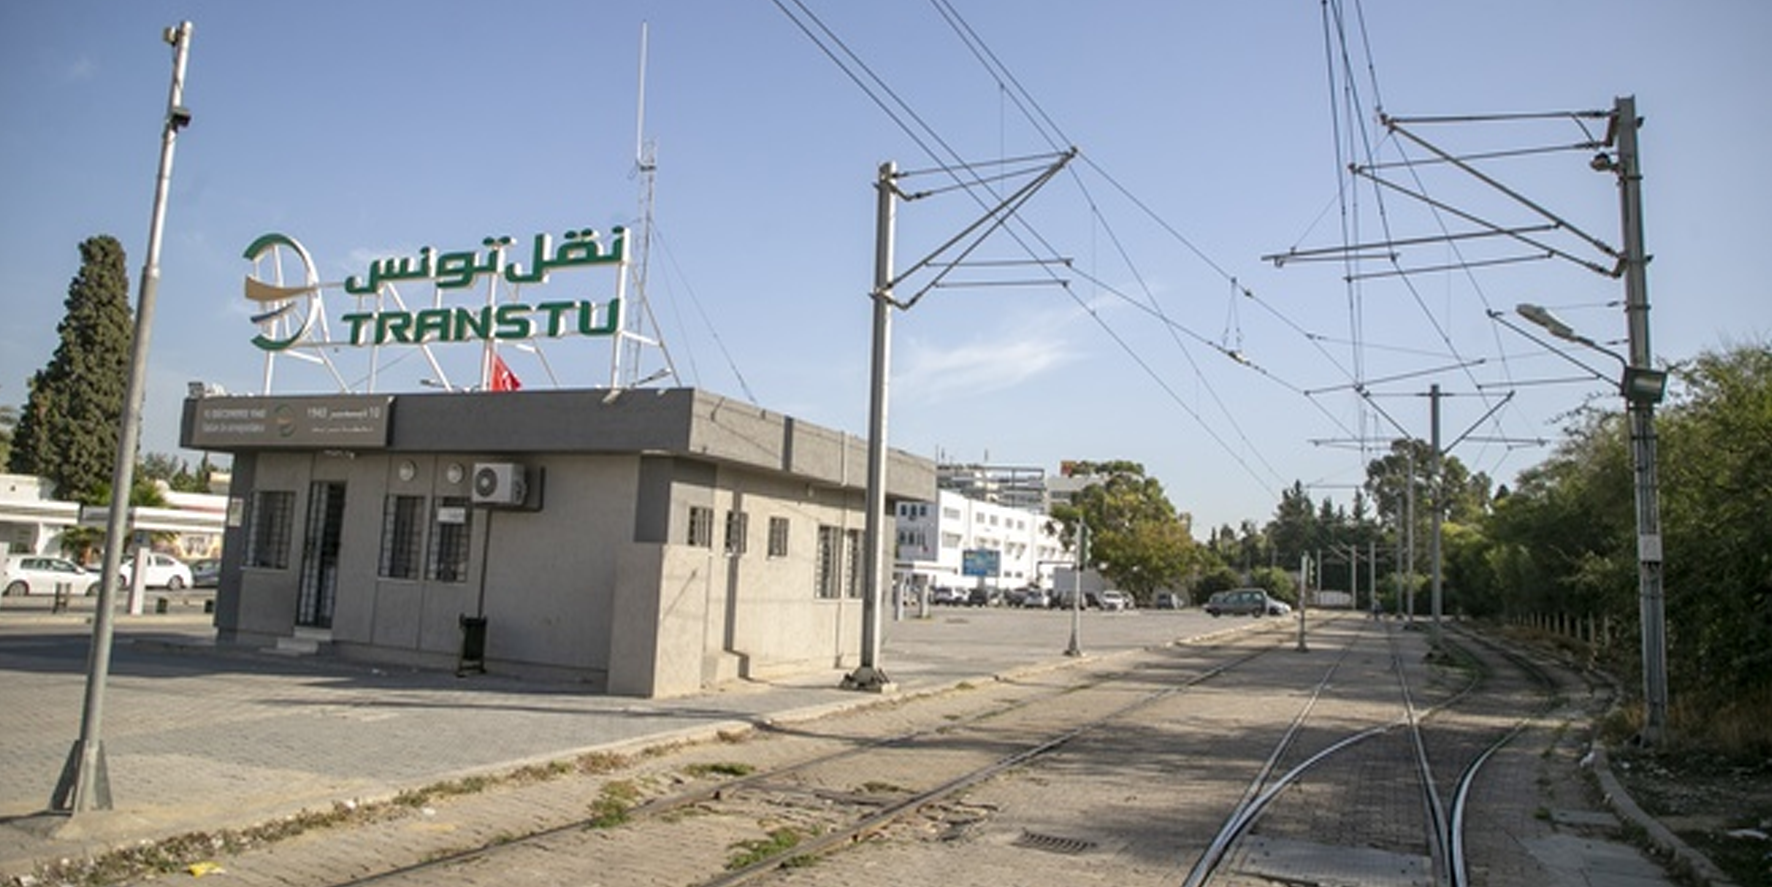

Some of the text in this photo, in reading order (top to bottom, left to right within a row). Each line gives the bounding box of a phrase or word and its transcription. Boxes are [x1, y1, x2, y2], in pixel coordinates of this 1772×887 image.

[345, 226, 628, 294] نقل تونس
[341, 298, 621, 345] TRANSTU
